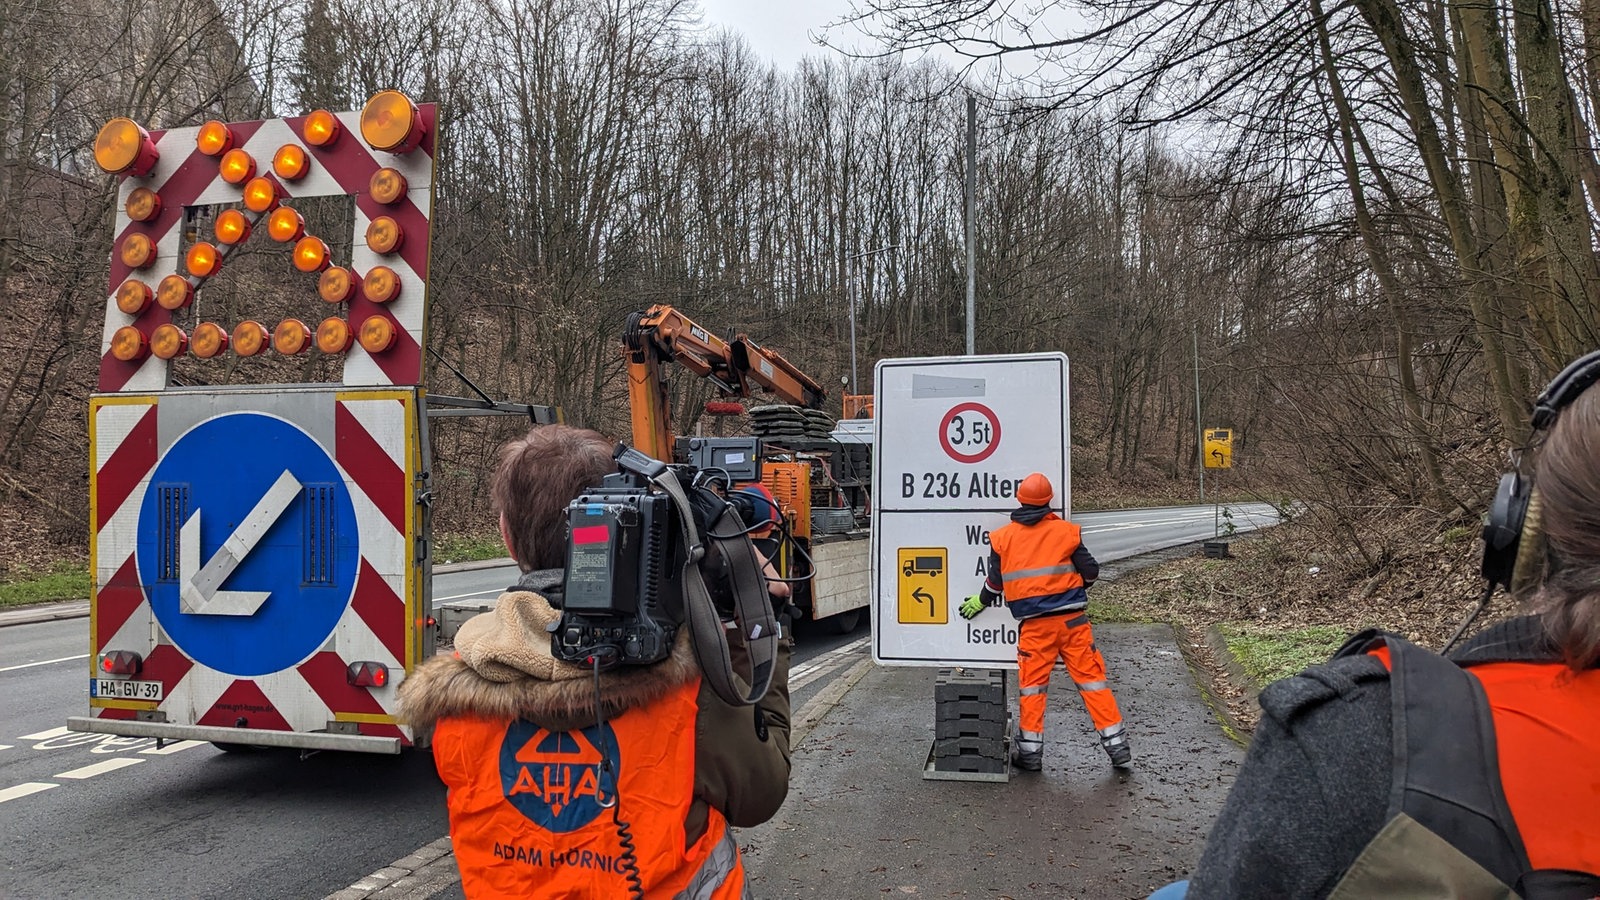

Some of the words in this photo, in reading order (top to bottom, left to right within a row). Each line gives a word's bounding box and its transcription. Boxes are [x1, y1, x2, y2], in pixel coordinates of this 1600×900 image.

[950, 415, 991, 446] 3,5t
[902, 473, 915, 498] B
[922, 472, 961, 498] 236
[100, 681, 116, 696] HA
[509, 765, 604, 806] AHA
[494, 842, 543, 868] ADAM
